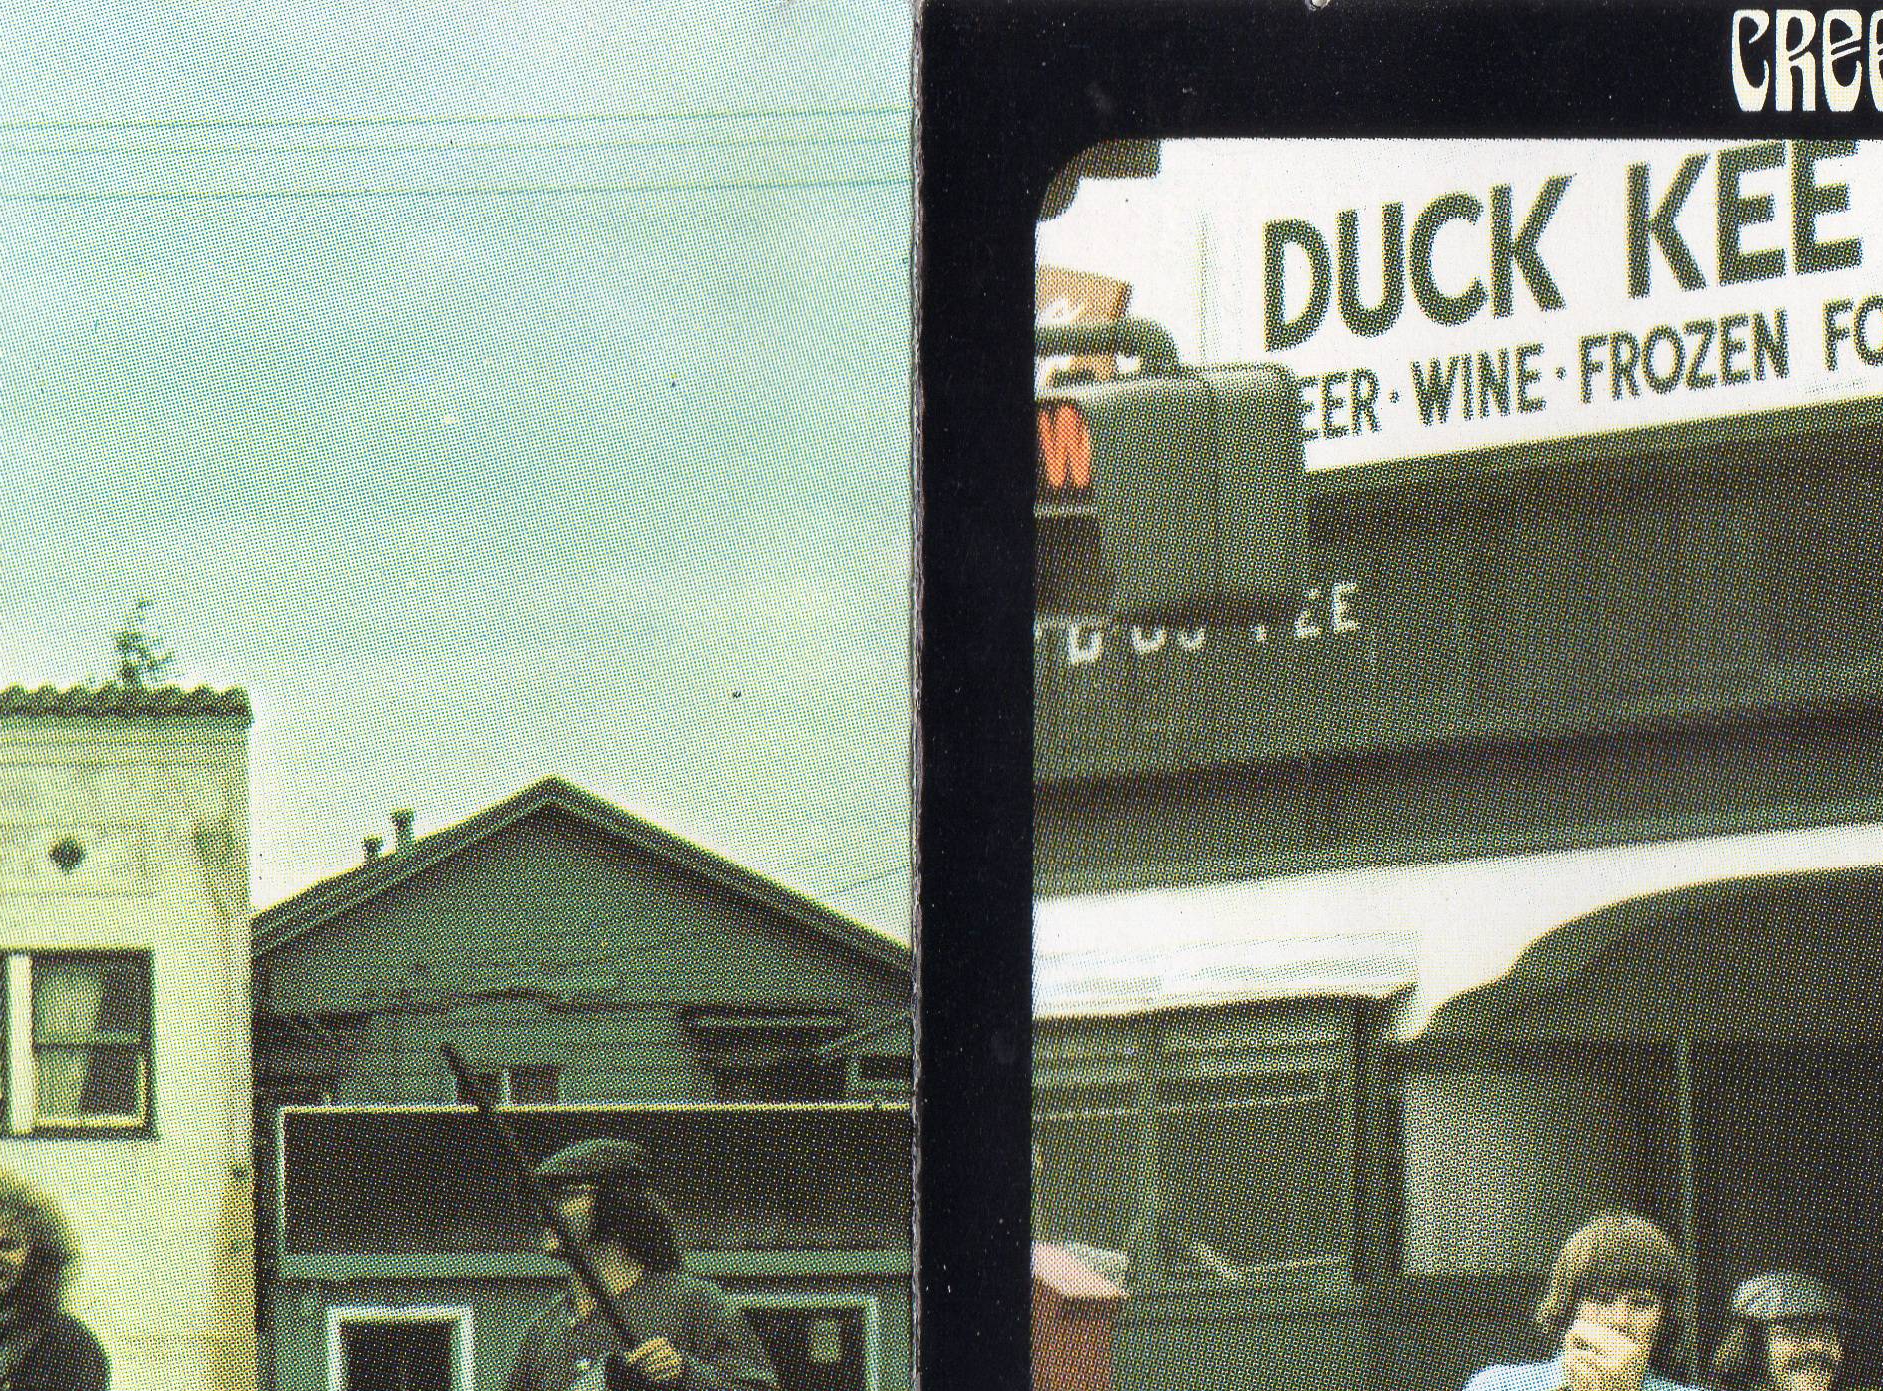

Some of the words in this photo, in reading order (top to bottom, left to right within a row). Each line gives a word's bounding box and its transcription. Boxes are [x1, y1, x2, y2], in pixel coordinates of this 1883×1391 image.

[1262, 173, 1576, 352] DUCK
[1625, 140, 1864, 299] KEE
[1299, 368, 1382, 441] EER
[1409, 343, 1547, 428] WINE
[1579, 307, 1790, 404] FROZEN
